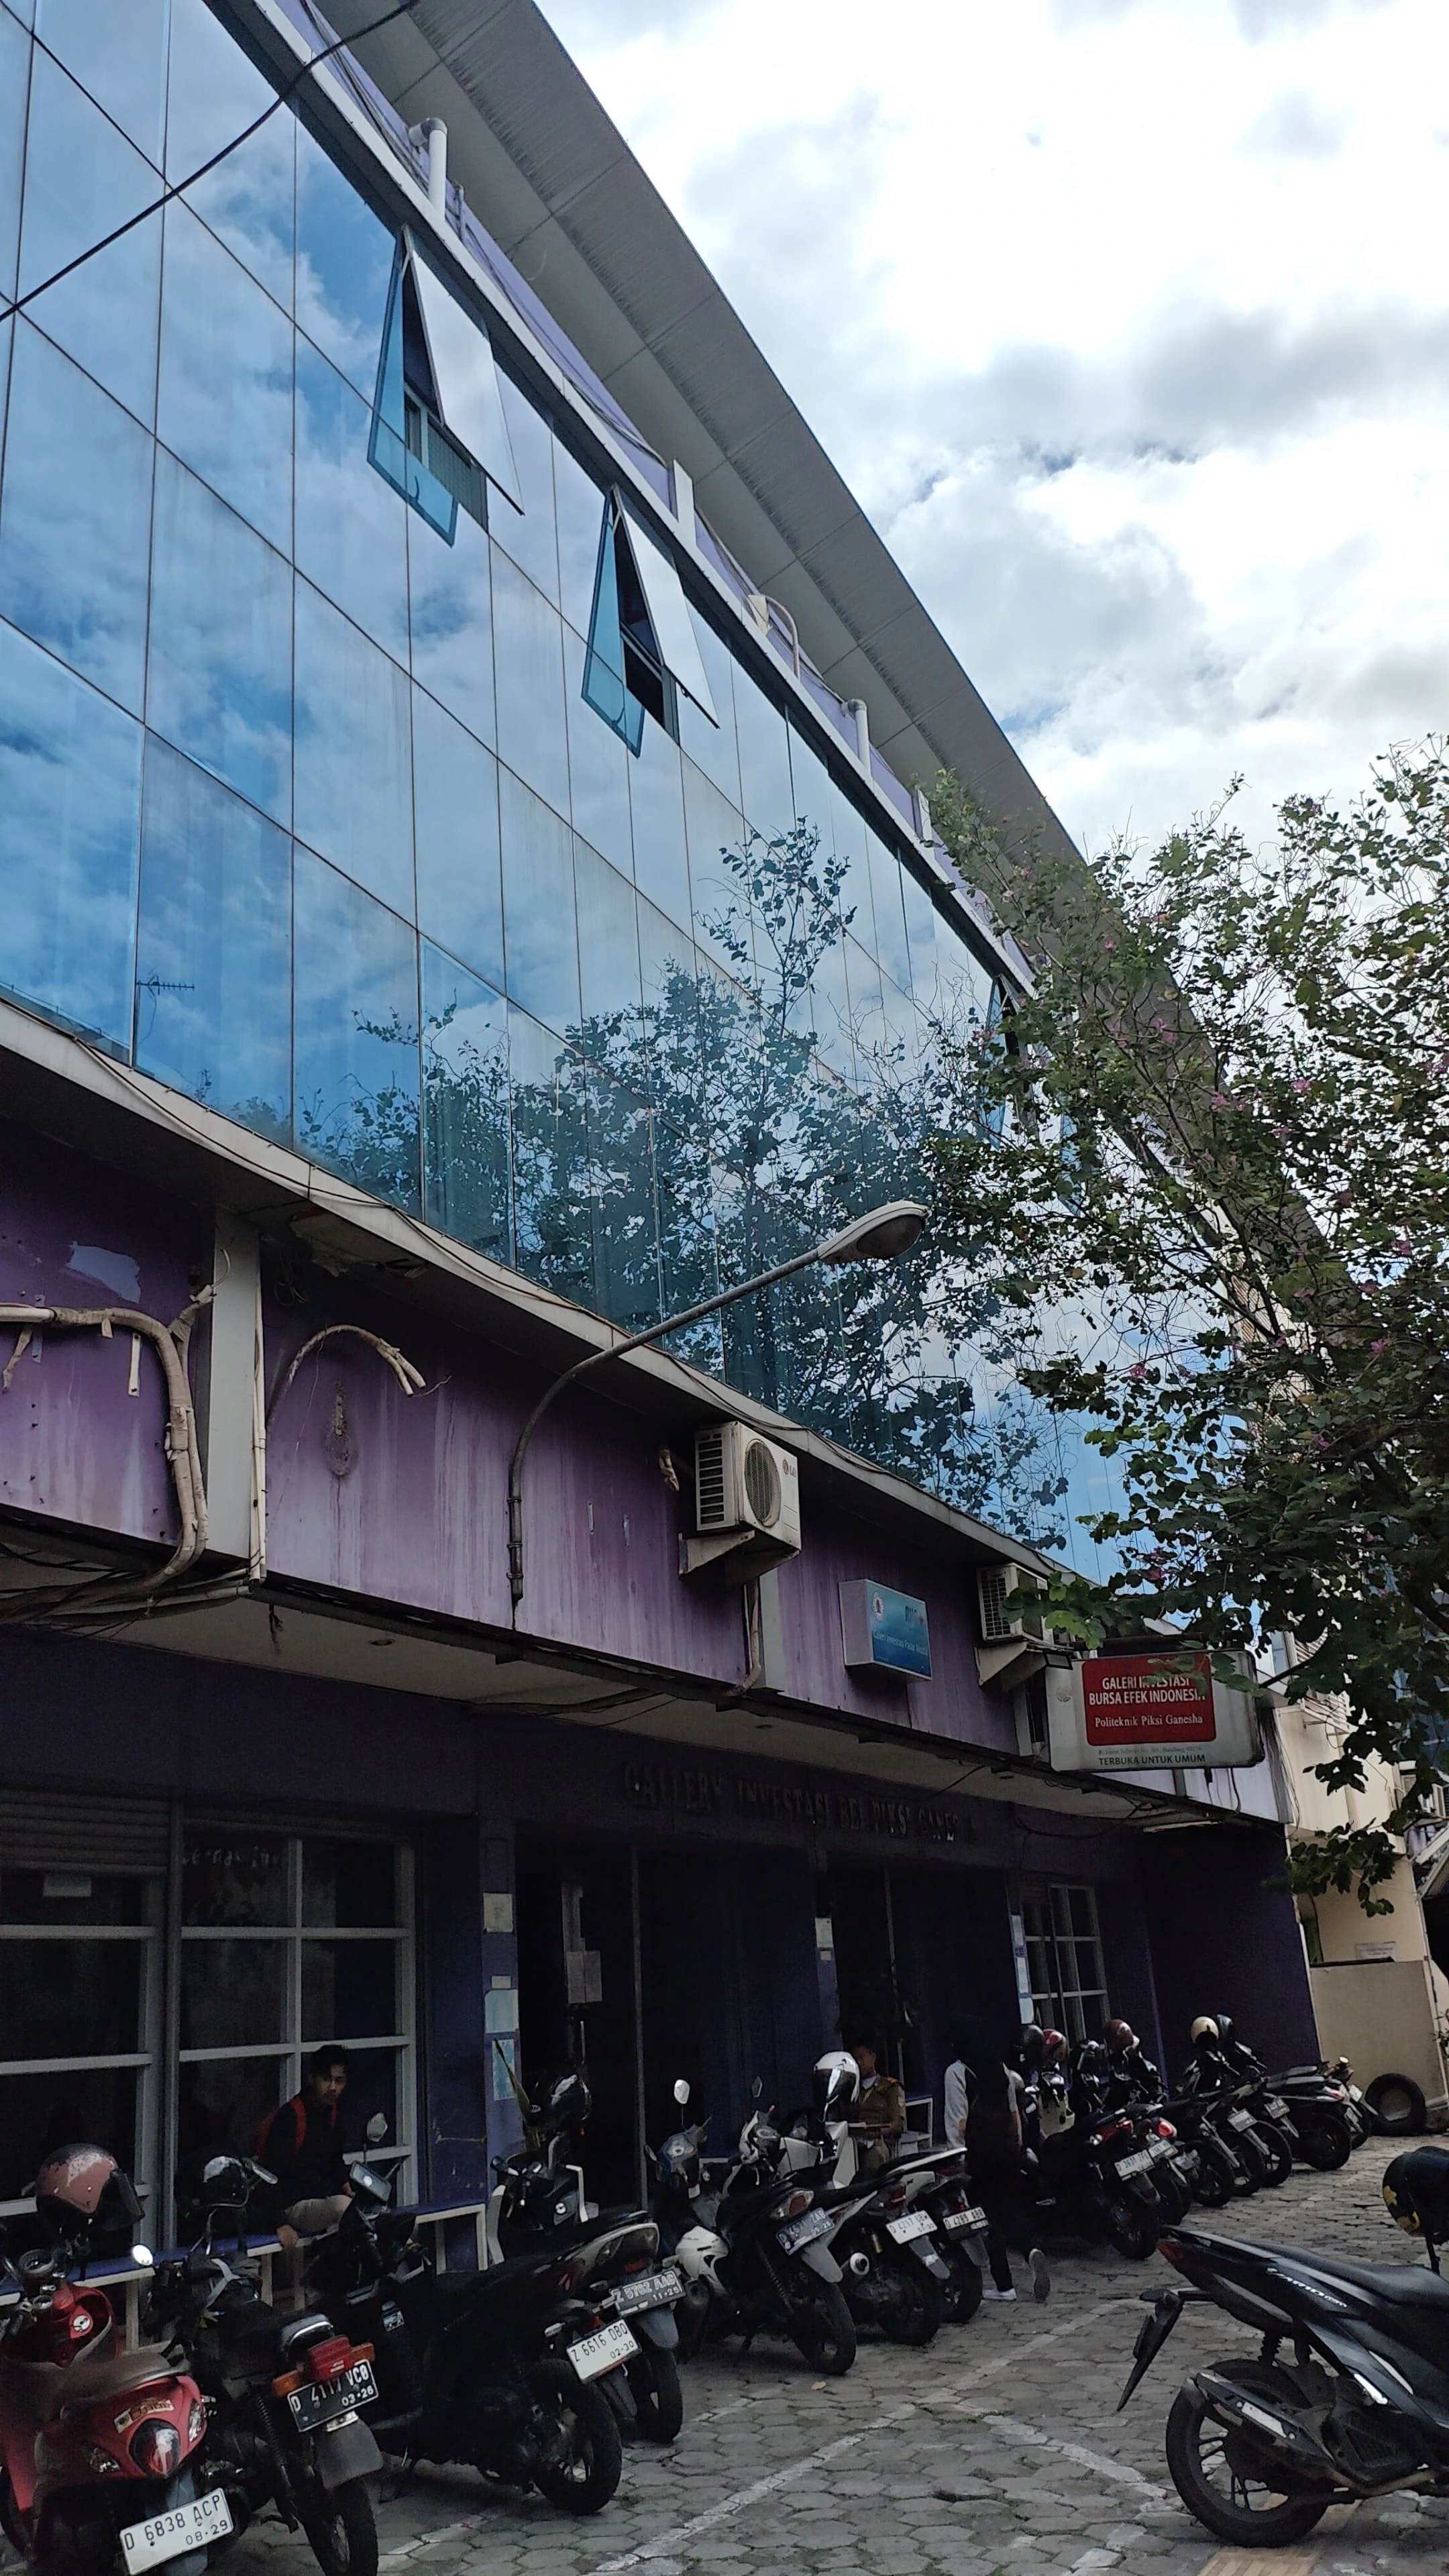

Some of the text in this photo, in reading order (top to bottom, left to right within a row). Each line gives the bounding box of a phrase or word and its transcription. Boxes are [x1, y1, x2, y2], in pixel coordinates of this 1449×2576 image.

[1102, 1674, 1189, 1690] GALERI IESTASI
[1089, 1688, 1205, 1705] BURSA EFEK INDONESI
[1095, 1713, 1203, 1727] Politeknik Piksi Ganesha
[1099, 1754, 1205, 1766] TERBUKA UNTUK UMUM
[779, 2233, 788, 2243] D
[614, 2290, 624, 2303] Z
[571, 2349, 580, 2362] Z
[581, 2334, 606, 2356] 6616
[290, 2396, 301, 2412] D
[124, 2494, 220, 2551] D 6838 ACP
